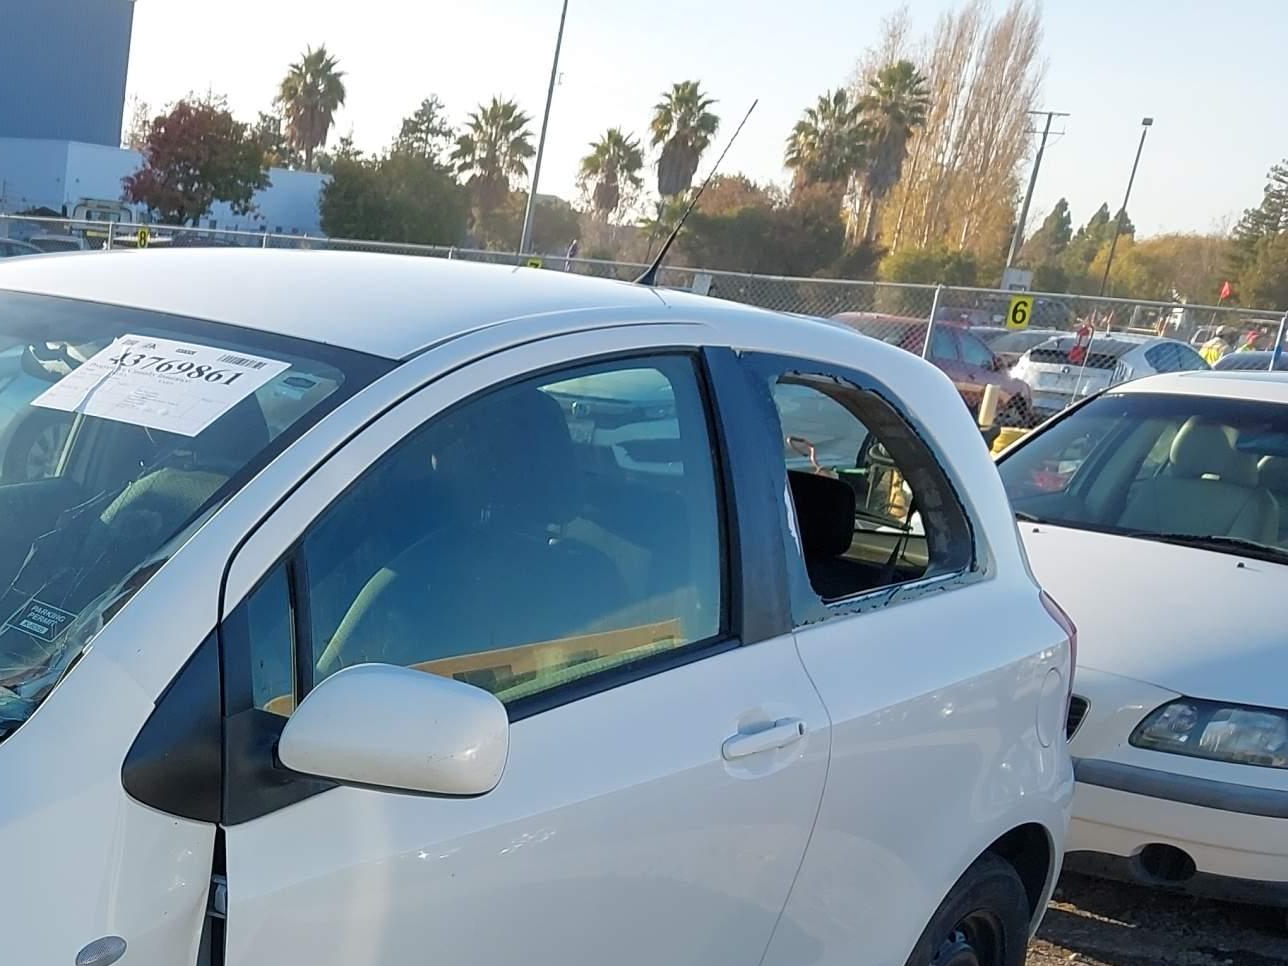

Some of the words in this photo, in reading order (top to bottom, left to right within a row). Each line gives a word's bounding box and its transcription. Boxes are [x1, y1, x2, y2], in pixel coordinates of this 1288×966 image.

[139, 230, 147, 248] 8
[1012, 300, 1028, 325] 6
[26, 611, 58, 627] PERMIT
[31, 605, 67, 623] PARKING
